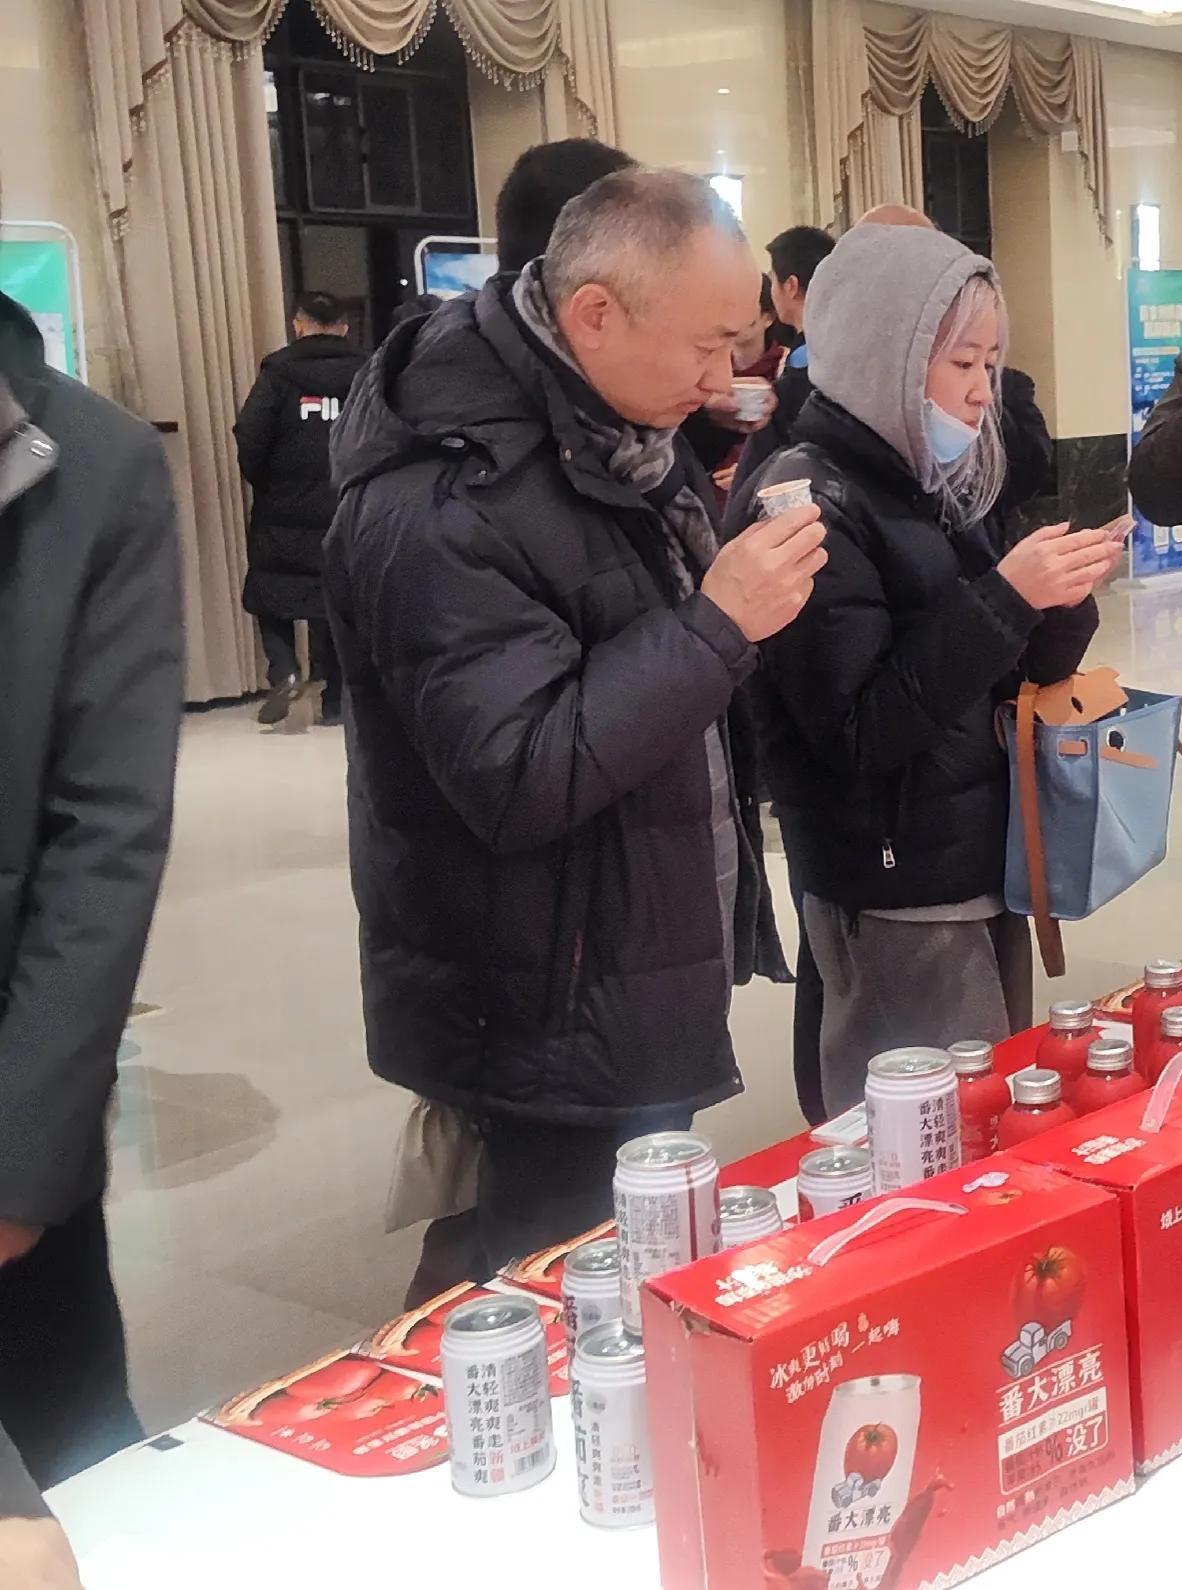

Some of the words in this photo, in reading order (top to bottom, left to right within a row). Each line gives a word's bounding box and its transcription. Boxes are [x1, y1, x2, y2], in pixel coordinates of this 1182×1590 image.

[999, 1351, 1104, 1424] 番大漂亮
[1067, 1415, 1103, 1458] 没了
